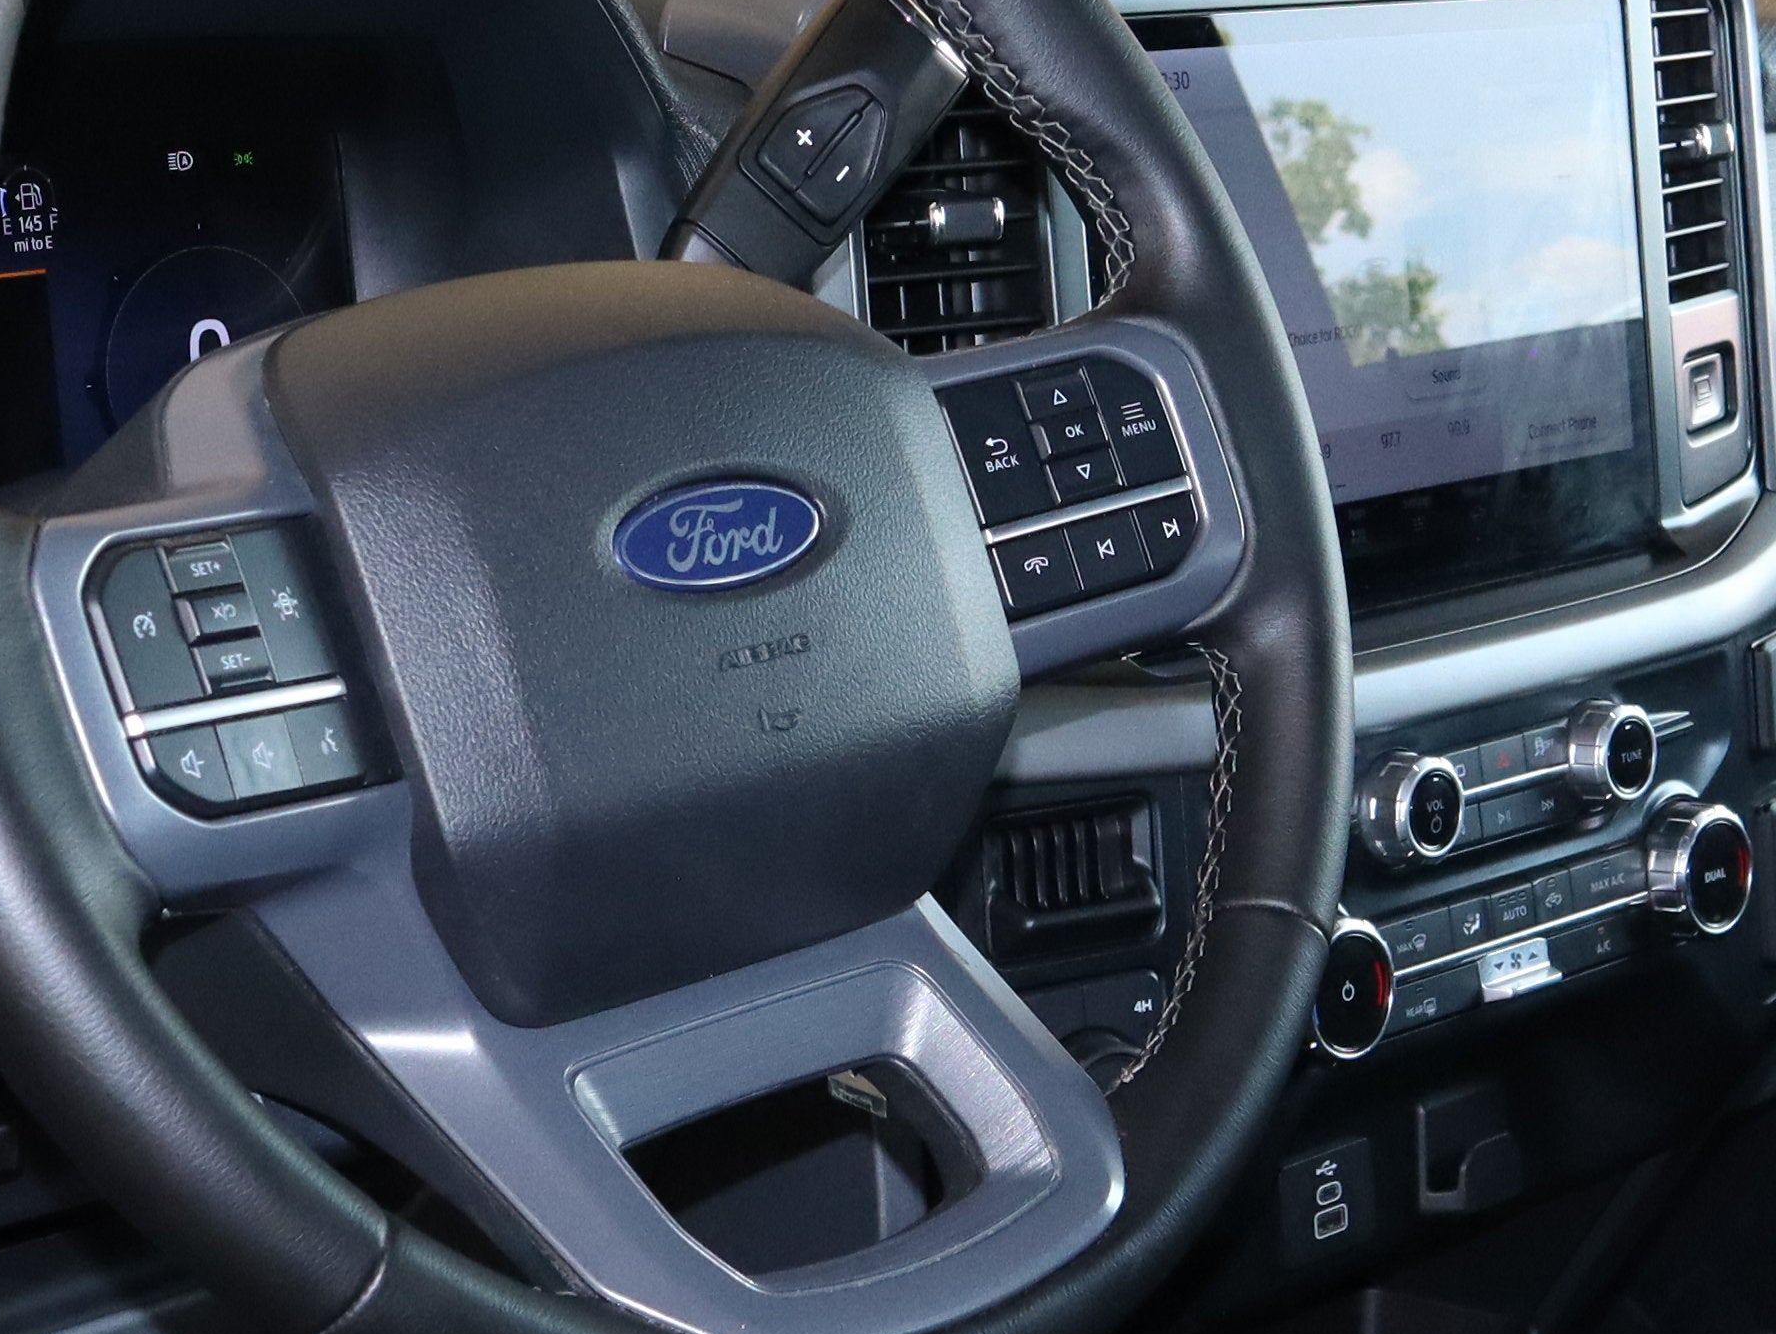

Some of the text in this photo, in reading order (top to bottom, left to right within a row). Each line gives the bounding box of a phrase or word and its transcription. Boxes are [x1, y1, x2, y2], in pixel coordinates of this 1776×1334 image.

[18, 215, 43, 233] 145
[14, 235, 53, 253] mi to E
[1065, 424, 1085, 439] OK
[1121, 419, 1157, 437] MENU
[985, 454, 1020, 473] BACK
[667, 498, 783, 573] Ford
[190, 560, 221, 577] SET+
[1620, 749, 1643, 764] TUNE
[1426, 799, 1445, 813] VOL
[1590, 874, 1626, 893] MAX A/C
[1704, 869, 1726, 884] DUAL
[1503, 905, 1527, 922] AUTO
[1596, 940, 1611, 955] A/C
[1133, 997, 1153, 1015] 4H
